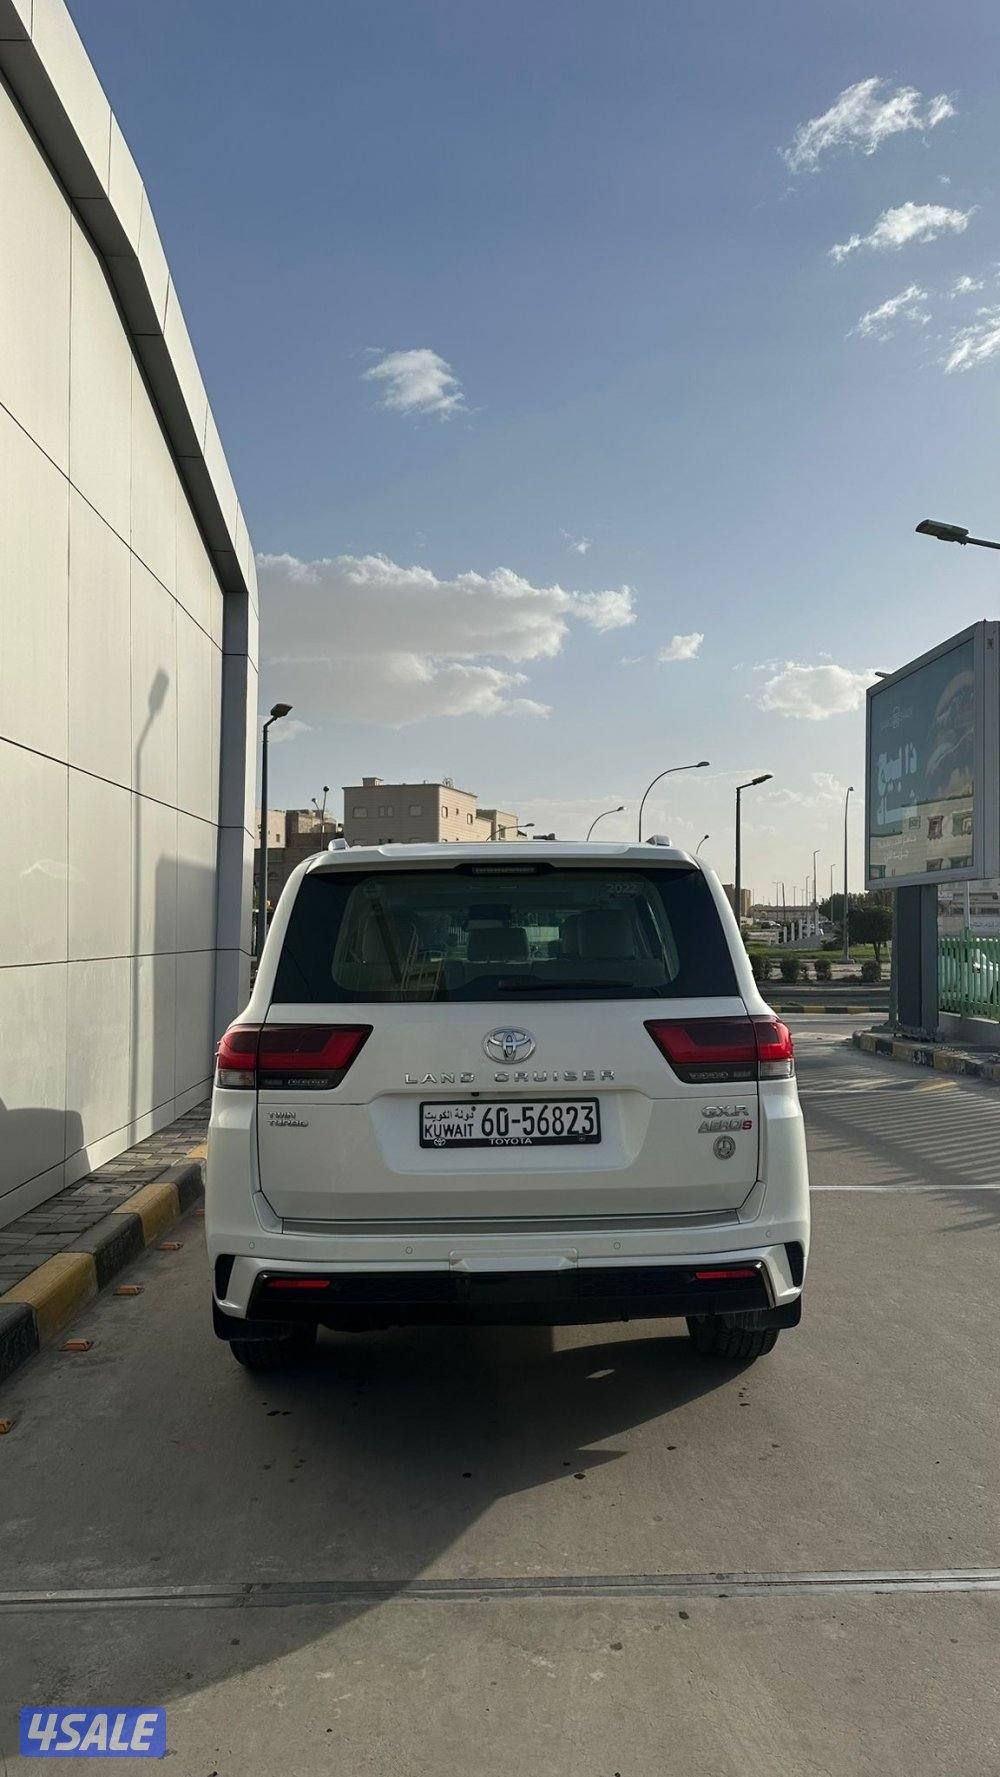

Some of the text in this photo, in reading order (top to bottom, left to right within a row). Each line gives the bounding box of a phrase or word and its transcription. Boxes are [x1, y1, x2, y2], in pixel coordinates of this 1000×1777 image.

[404, 1071, 615, 1084] LAND CRUISER
[481, 1106, 594, 1137] 60-56823
[424, 1124, 474, 1138] KUWAIT
[489, 1137, 533, 1145] TOYOTA
